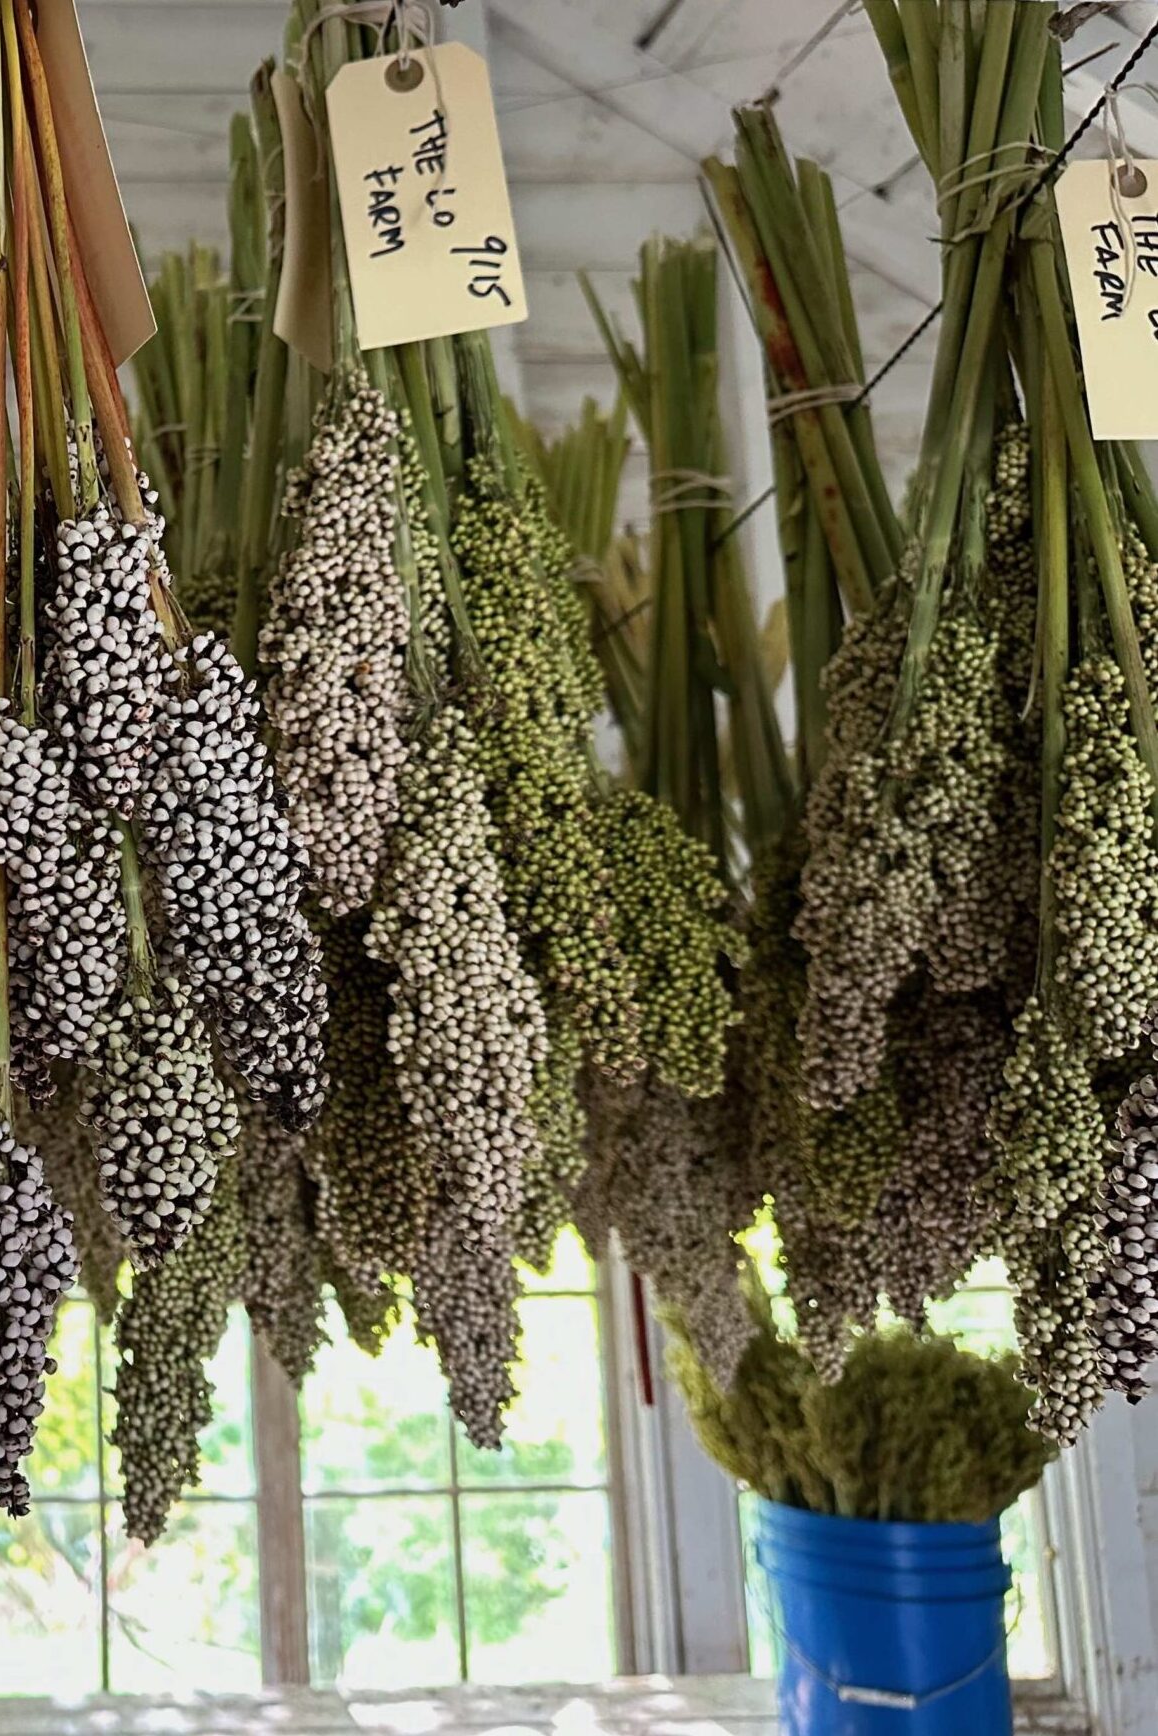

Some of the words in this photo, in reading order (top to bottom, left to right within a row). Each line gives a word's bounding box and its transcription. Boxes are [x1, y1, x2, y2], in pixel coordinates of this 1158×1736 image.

[409, 109, 447, 175] THE
[363, 165, 405, 258] FARM
[450, 235, 511, 307] 9/15
[1091, 221, 1125, 321] FARM
